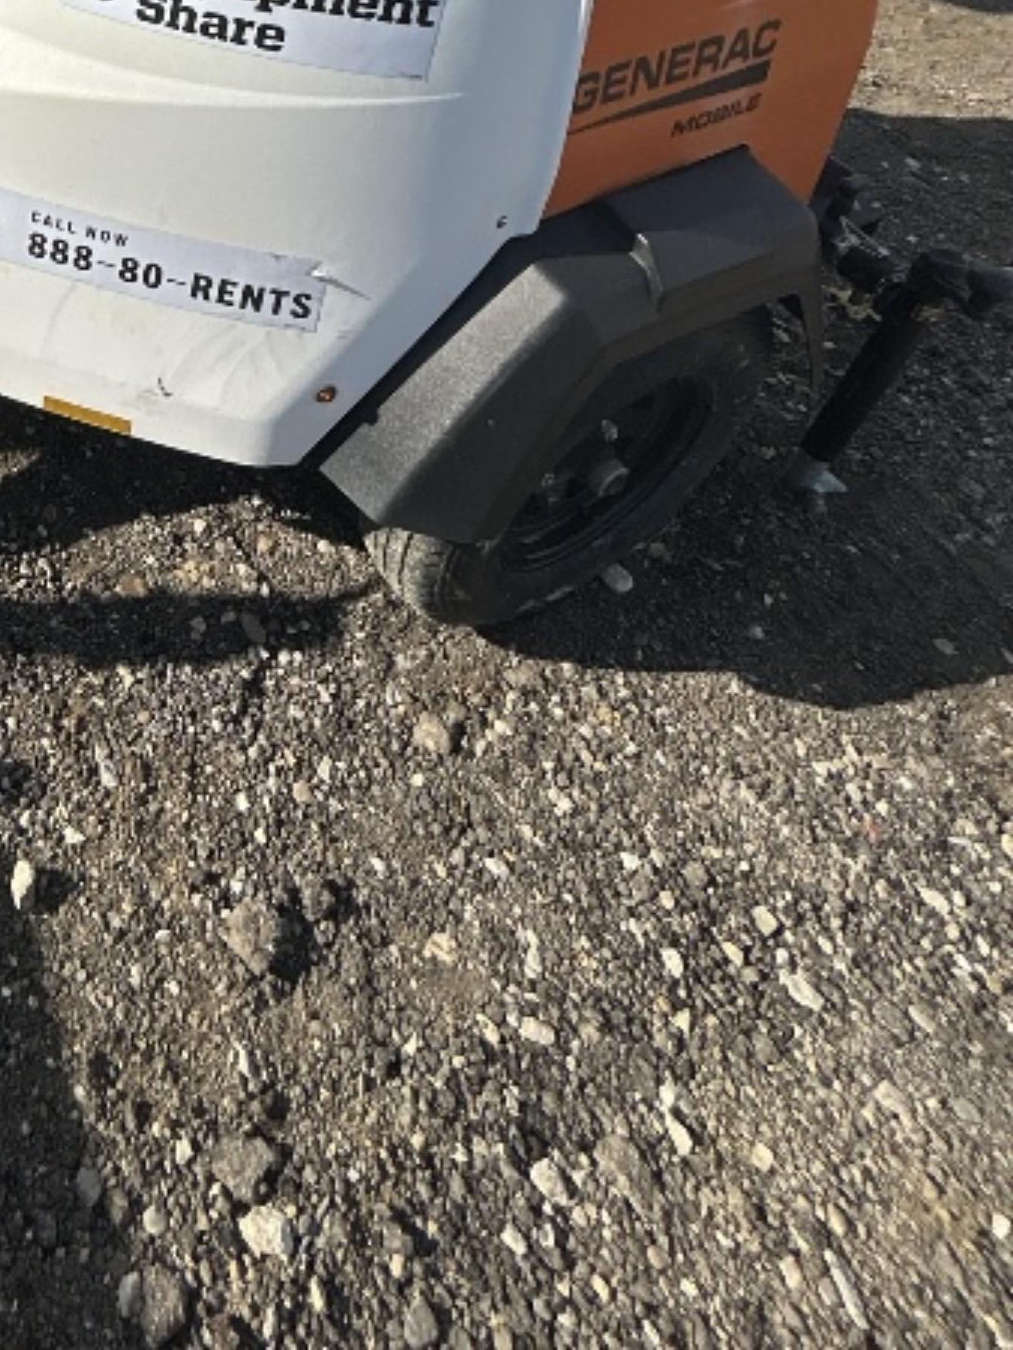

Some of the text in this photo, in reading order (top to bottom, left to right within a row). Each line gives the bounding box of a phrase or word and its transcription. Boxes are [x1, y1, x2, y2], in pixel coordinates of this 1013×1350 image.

[572, 17, 783, 115] GENERAC
[670, 92, 763, 138] MOBILE
[30, 210, 129, 248] CALL NOW
[27, 232, 314, 320] 888-80-RENTS
